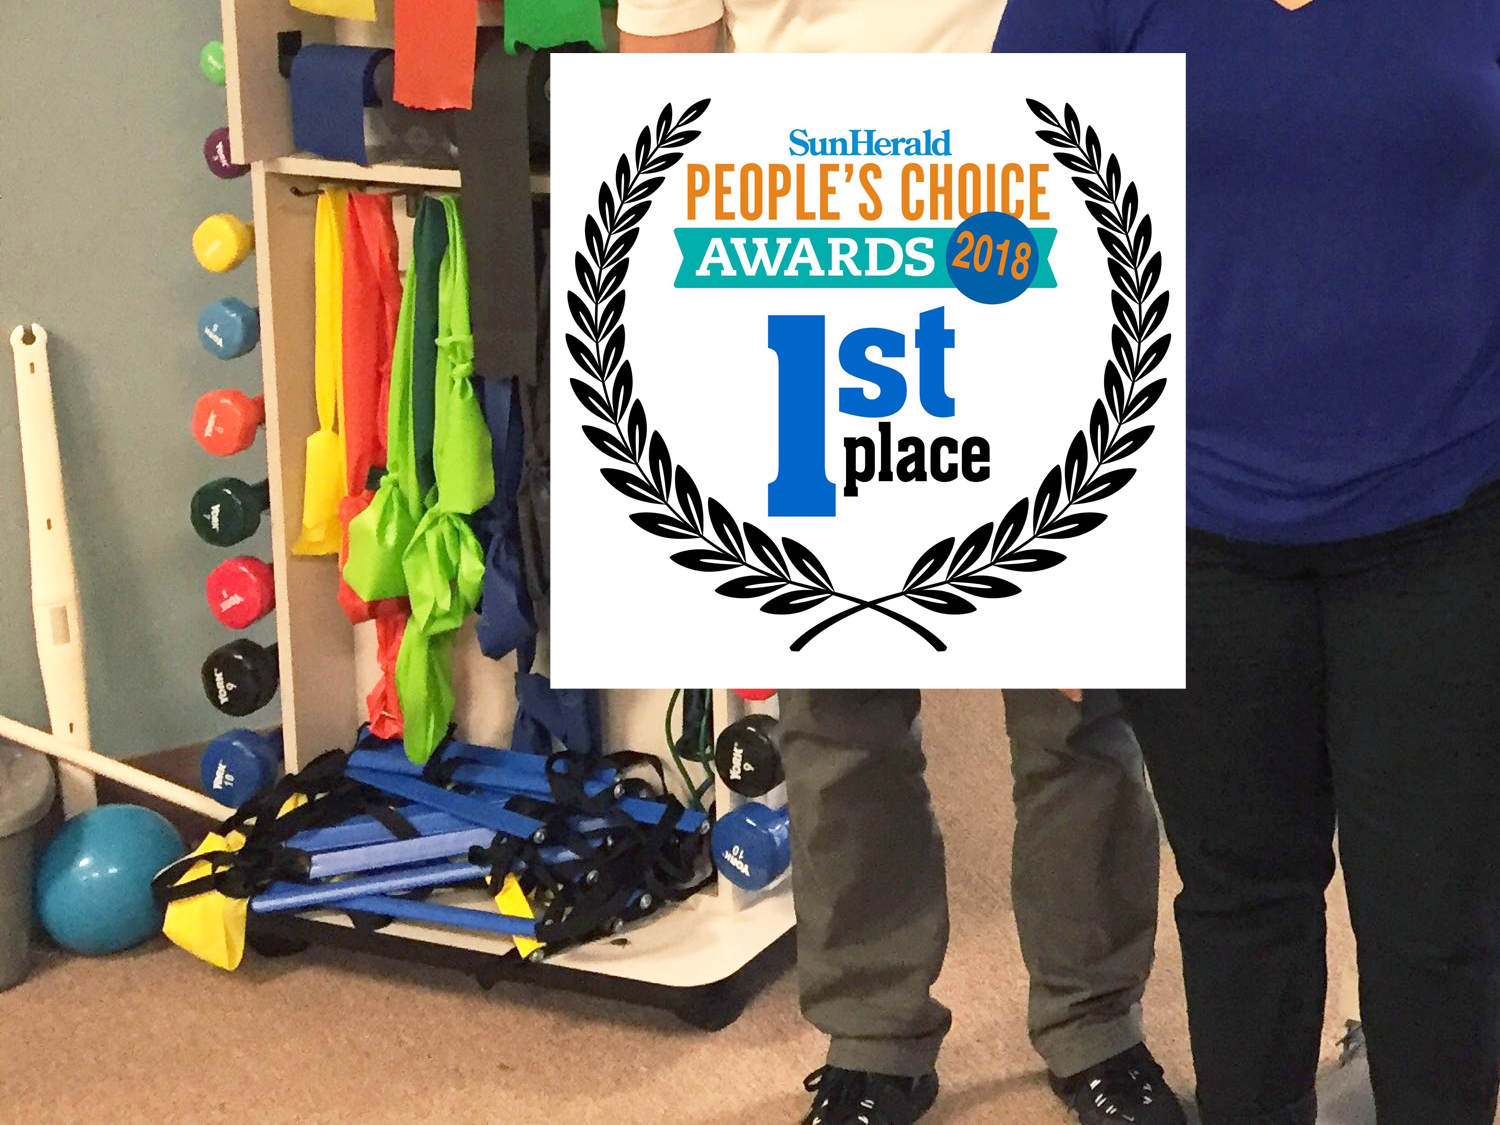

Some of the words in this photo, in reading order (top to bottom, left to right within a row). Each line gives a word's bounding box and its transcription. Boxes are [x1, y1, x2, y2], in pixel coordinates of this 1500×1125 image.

[214, 671, 229, 705] YORK
[213, 763, 227, 789] YORK
[730, 747, 744, 780] YORK
[224, 774, 235, 788] 10
[724, 849, 750, 877] YORK
[732, 845, 745, 859] 10
